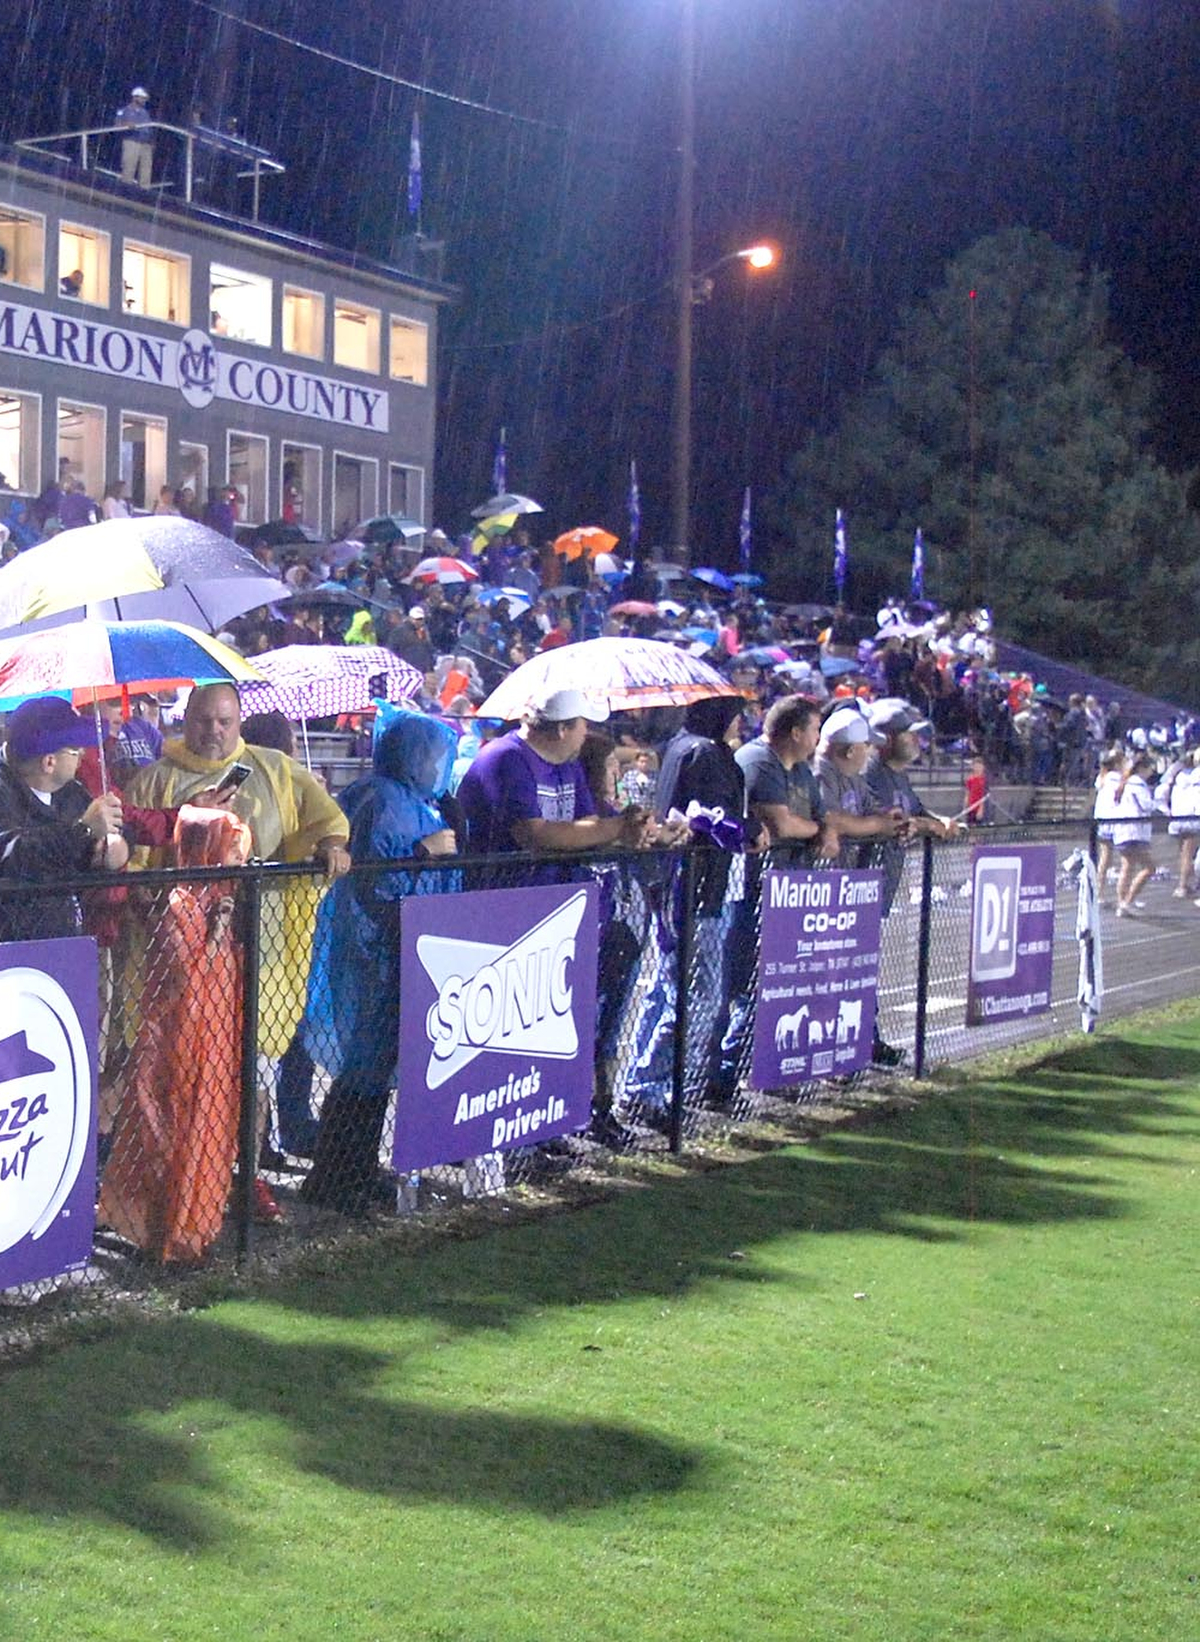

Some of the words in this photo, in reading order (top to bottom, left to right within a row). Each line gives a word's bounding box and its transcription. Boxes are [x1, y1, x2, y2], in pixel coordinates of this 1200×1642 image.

[228, 360, 381, 427] COUNTY
[770, 874, 831, 908] Marion
[803, 911, 857, 933] CO-OP
[428, 937, 575, 1061] SONIC
[453, 1065, 541, 1125] America's
